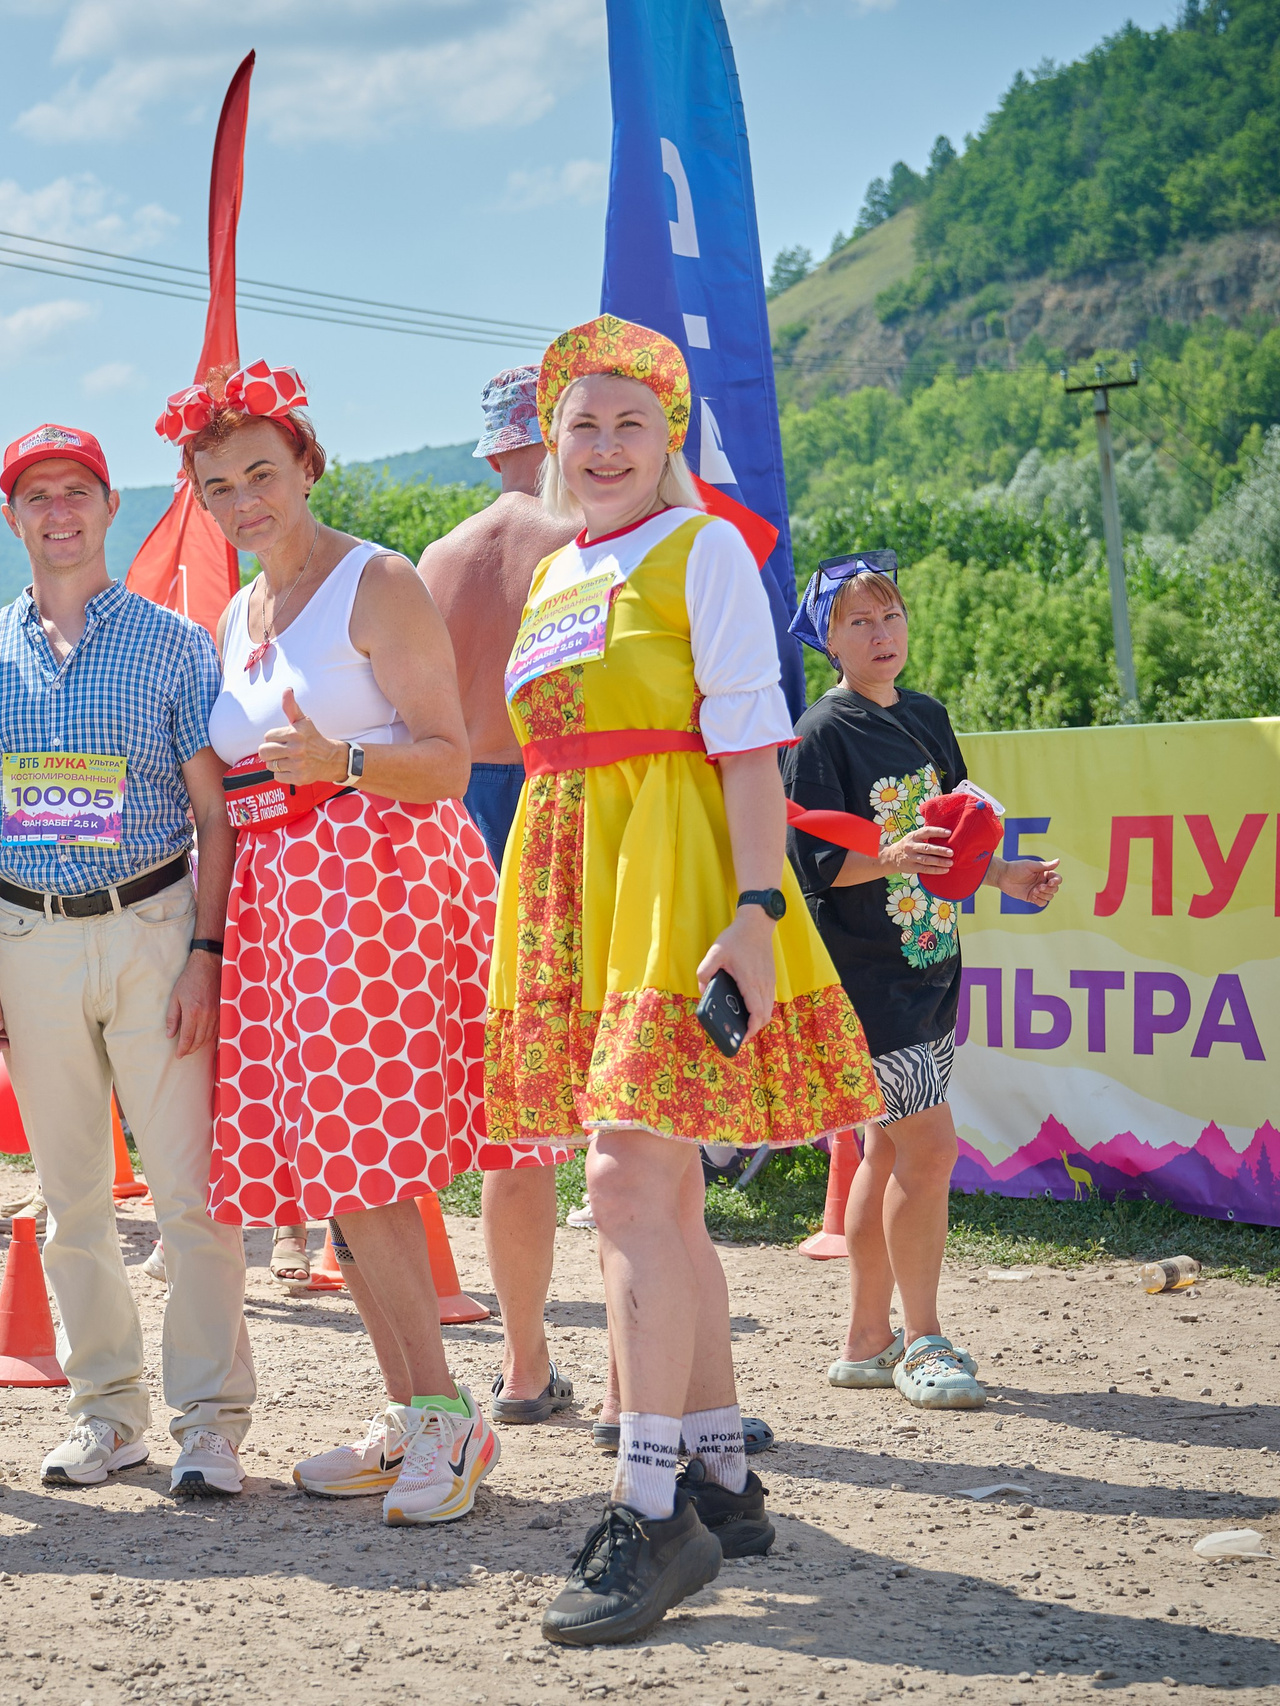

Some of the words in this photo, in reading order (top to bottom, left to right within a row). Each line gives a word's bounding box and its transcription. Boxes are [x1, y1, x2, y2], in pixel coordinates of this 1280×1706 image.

[542, 588, 578, 612] ЛУКА
[580, 577, 608, 591] УЛЬТРА
[514, 604, 601, 661] 10000
[18, 757, 40, 769] ВТБ
[43, 757, 87, 770] ЛУКА
[88, 759, 120, 768] УЛЬТРА
[11, 773, 116, 784] КОСТЮМИРОВАННЫЙ
[11, 786, 114, 809] 10005
[256, 788, 286, 808] ЖИЗНЬ
[246, 795, 260, 824] МОЯ
[259, 802, 289, 821] ЛЮБОВЬ
[22, 819, 40, 827] ФАН
[42, 819, 72, 827] ЗАБЕГ
[1093, 813, 1280, 919] ЛУ
[631, 1441, 640, 1449] Я
[700, 1434, 708, 1443] Я
[696, 1445, 721, 1454] МНЕ
[627, 1453, 652, 1466] МНЕ
